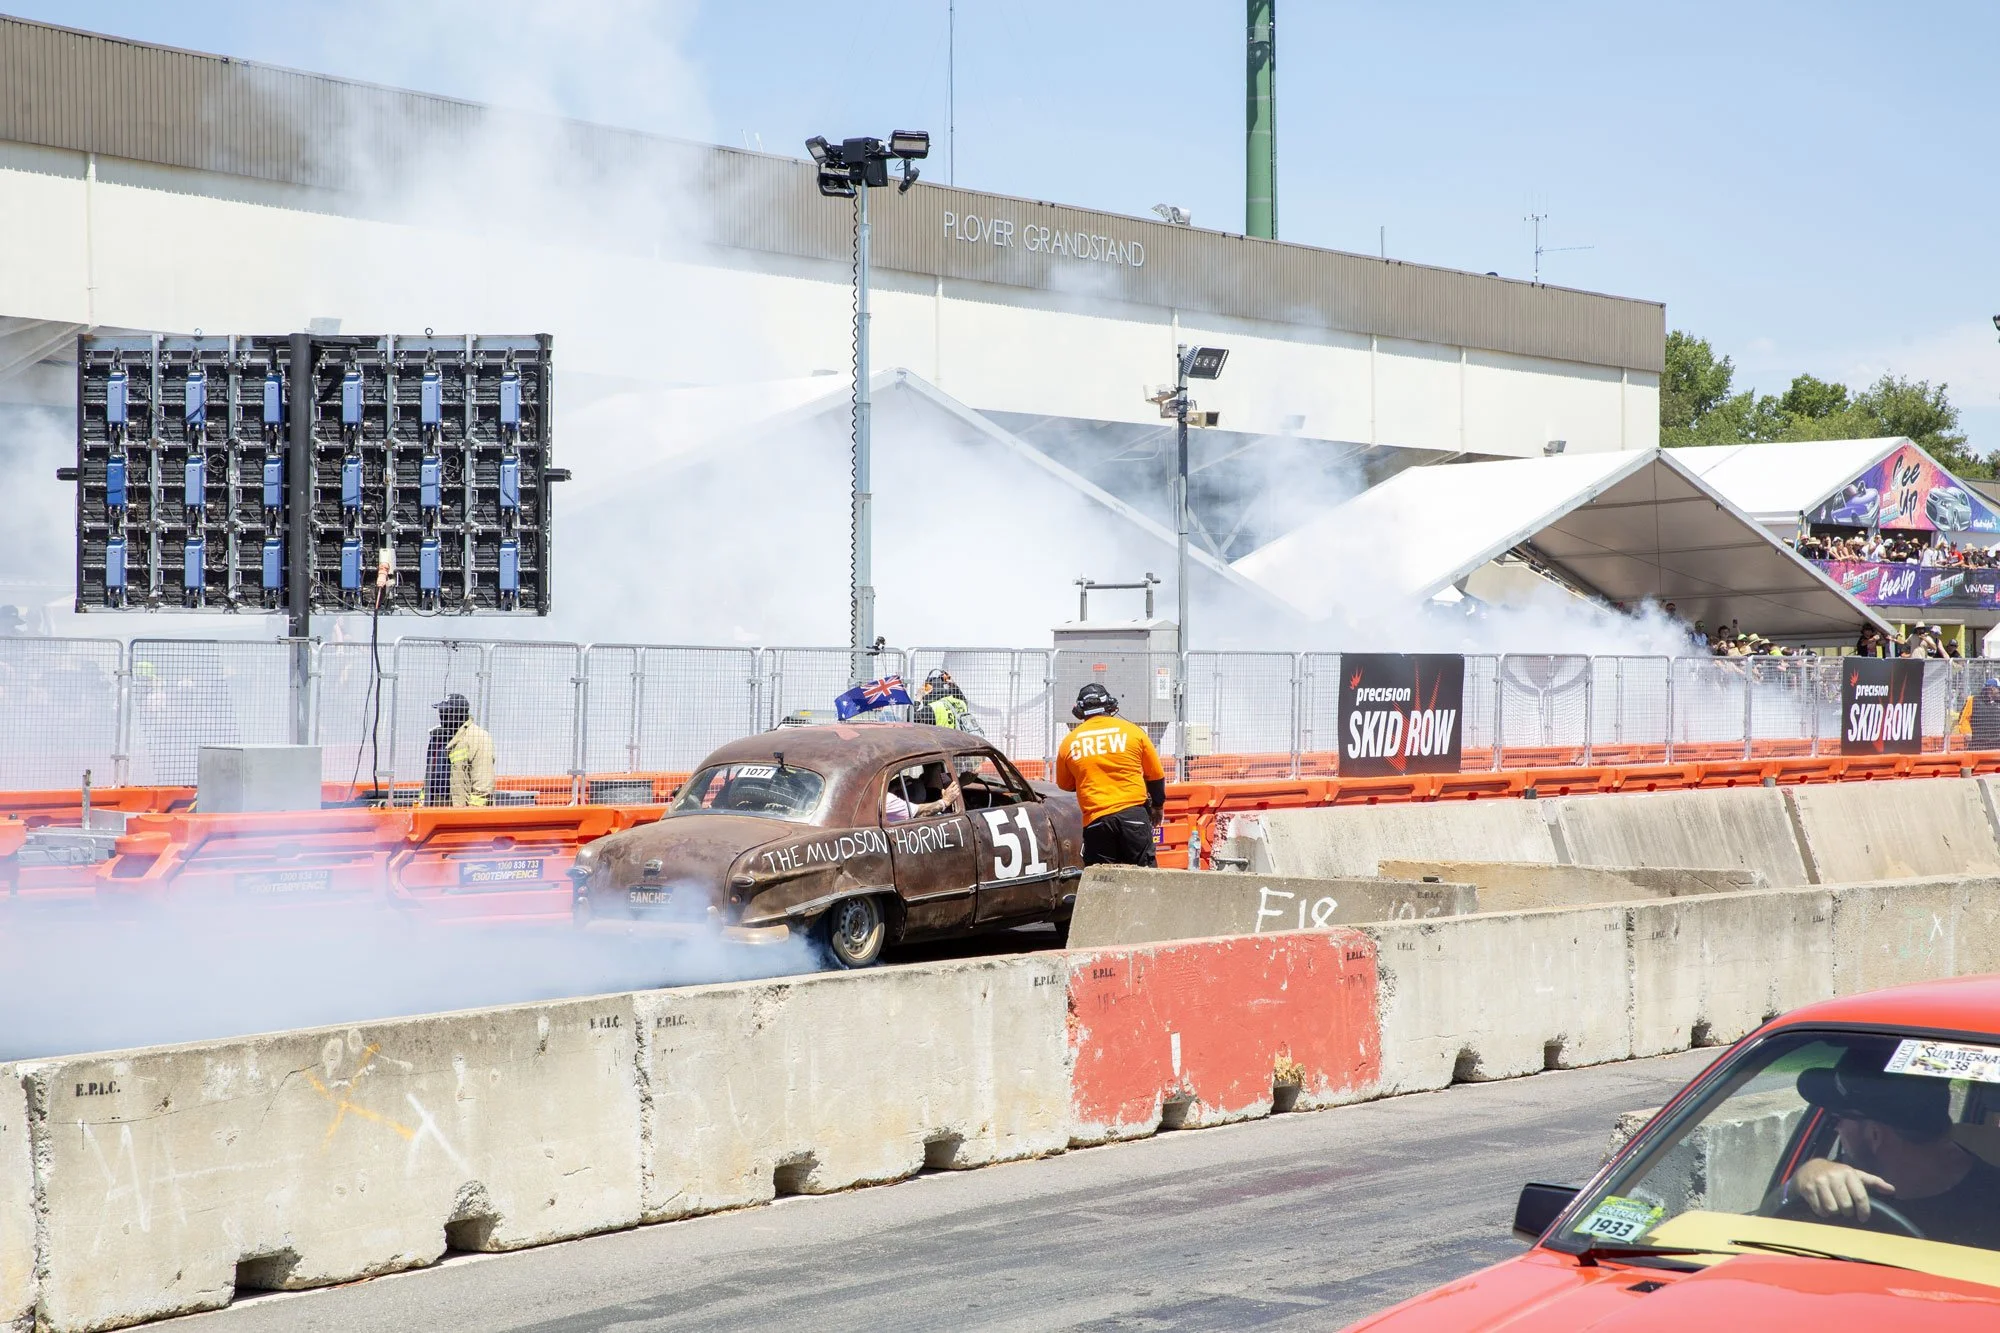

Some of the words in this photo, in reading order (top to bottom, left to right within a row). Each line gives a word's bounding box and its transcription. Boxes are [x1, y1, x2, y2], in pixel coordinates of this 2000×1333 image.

[944, 211, 1014, 248] PLOVER
[1023, 224, 1145, 267] GRANDSTAND
[1356, 688, 1411, 706] precision
[1855, 684, 1889, 700] precision
[1847, 703, 1884, 742] SKID
[1882, 703, 1918, 741] ROW
[1347, 710, 1404, 759] SKID
[1404, 709, 1457, 757] ROW
[1070, 733, 1127, 761] CREW
[745, 768, 771, 777] 1077
[763, 845, 804, 874] THE
[806, 829, 888, 864] MUDSON
[895, 819, 965, 855] HORNET
[982, 807, 1048, 880] 51
[514, 861, 526, 869] 836
[527, 860, 539, 869] 733
[1034, 974, 1059, 987] E.P.I.C.
[1093, 967, 1116, 979] E.P.I.C.
[656, 1014, 688, 1028] E.P.I.C.
[1951, 1061, 1970, 1071] 38
[76, 1081, 121, 1097] E.P.I.C.
[1589, 1217, 1634, 1237] 1933
